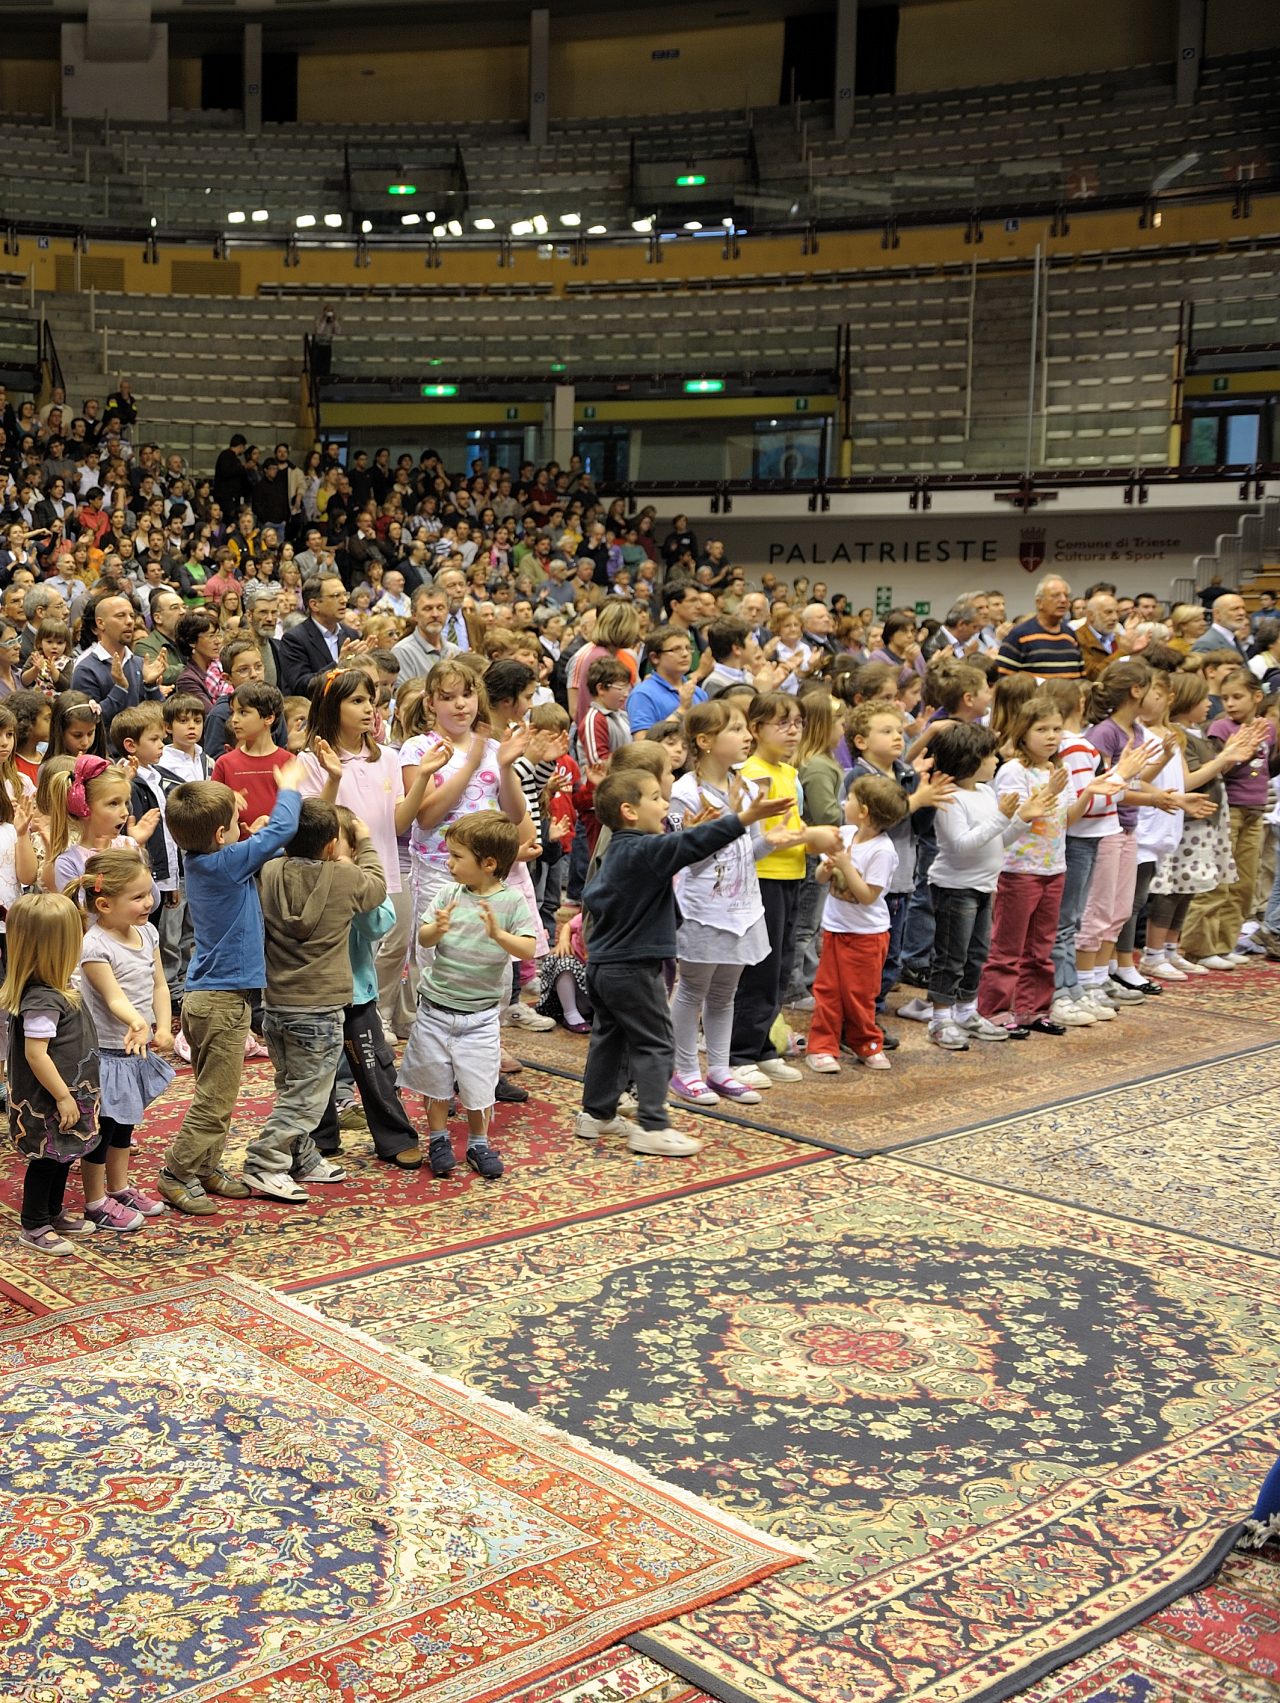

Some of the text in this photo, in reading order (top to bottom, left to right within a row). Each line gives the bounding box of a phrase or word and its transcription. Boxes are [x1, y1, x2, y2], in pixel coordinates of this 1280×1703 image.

[769, 540, 998, 564] PALATRIESTE
[1055, 537, 1181, 550] Comune di Trieste
[1054, 550, 1166, 563] Cultura & Sport
[359, 1029, 376, 1069] TYPE
